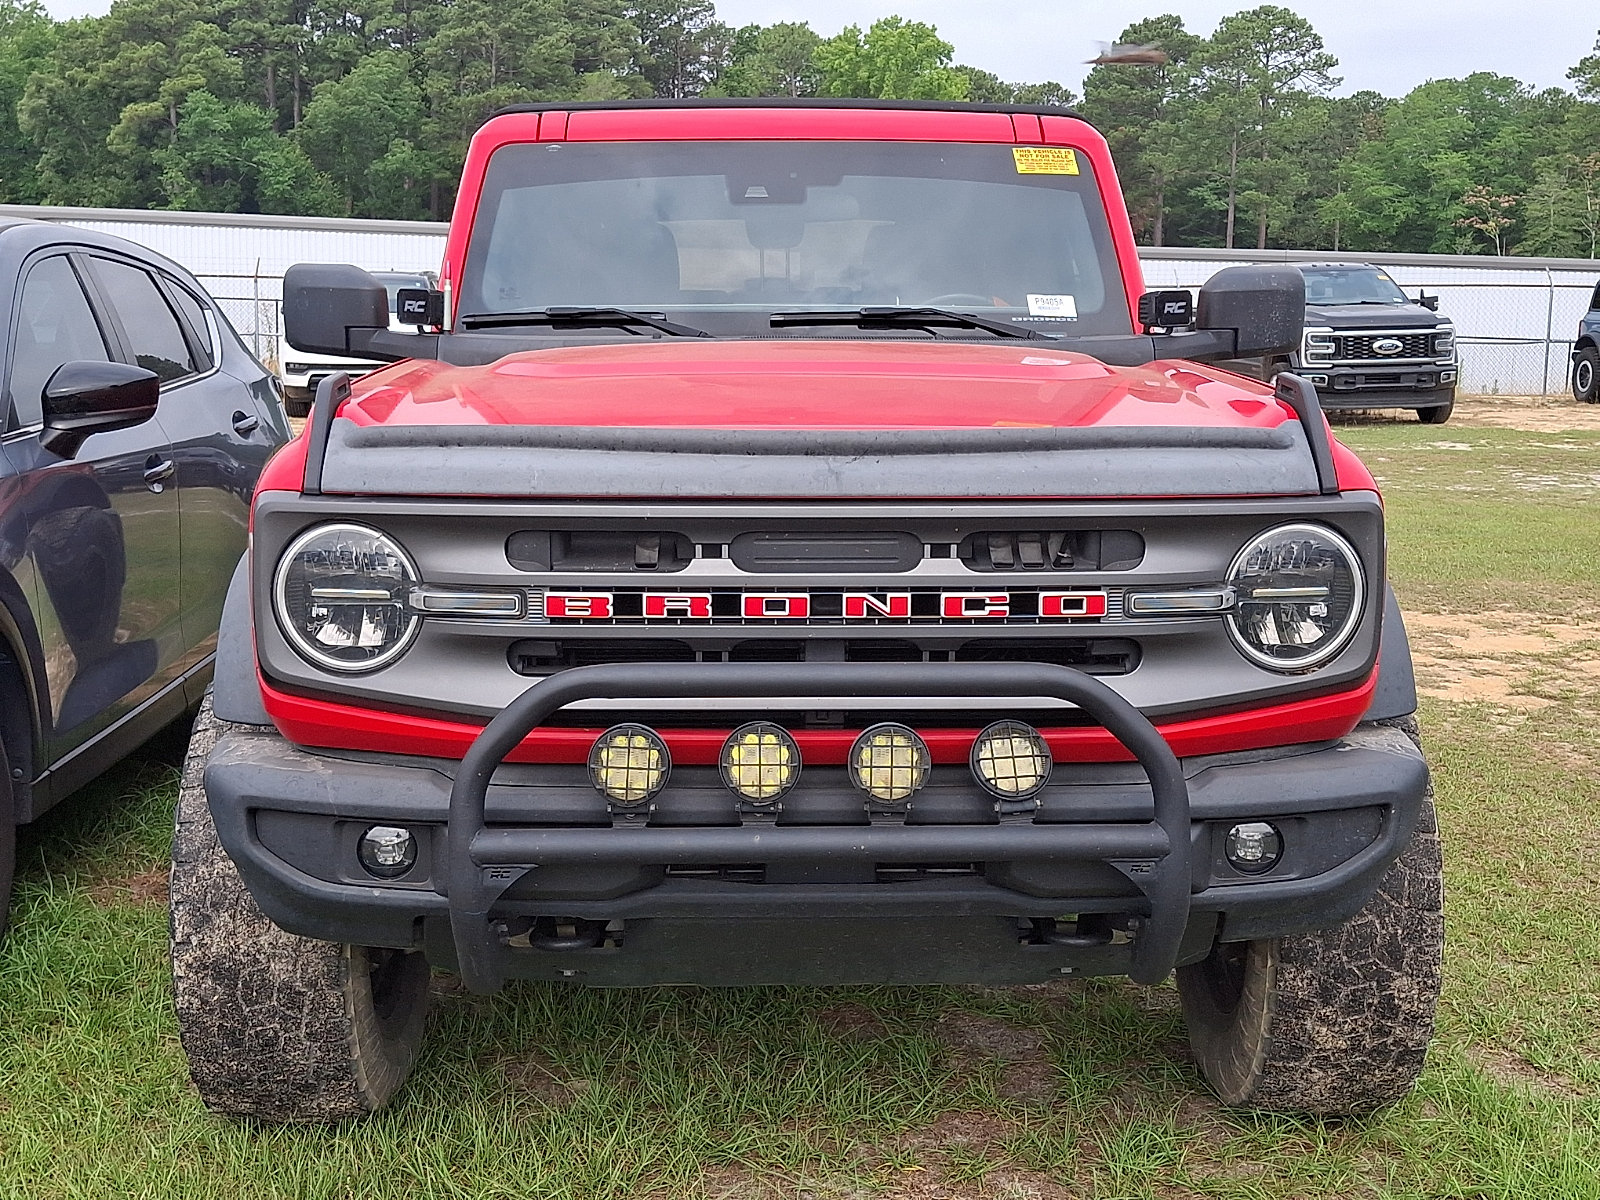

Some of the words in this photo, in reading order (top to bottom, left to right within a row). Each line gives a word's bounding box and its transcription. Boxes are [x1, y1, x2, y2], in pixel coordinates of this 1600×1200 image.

[404, 300, 426, 313] RC
[1163, 301, 1187, 314] RC
[544, 591, 1108, 618] BRONCO
[490, 870, 511, 879] RC
[1130, 864, 1151, 873] RC
